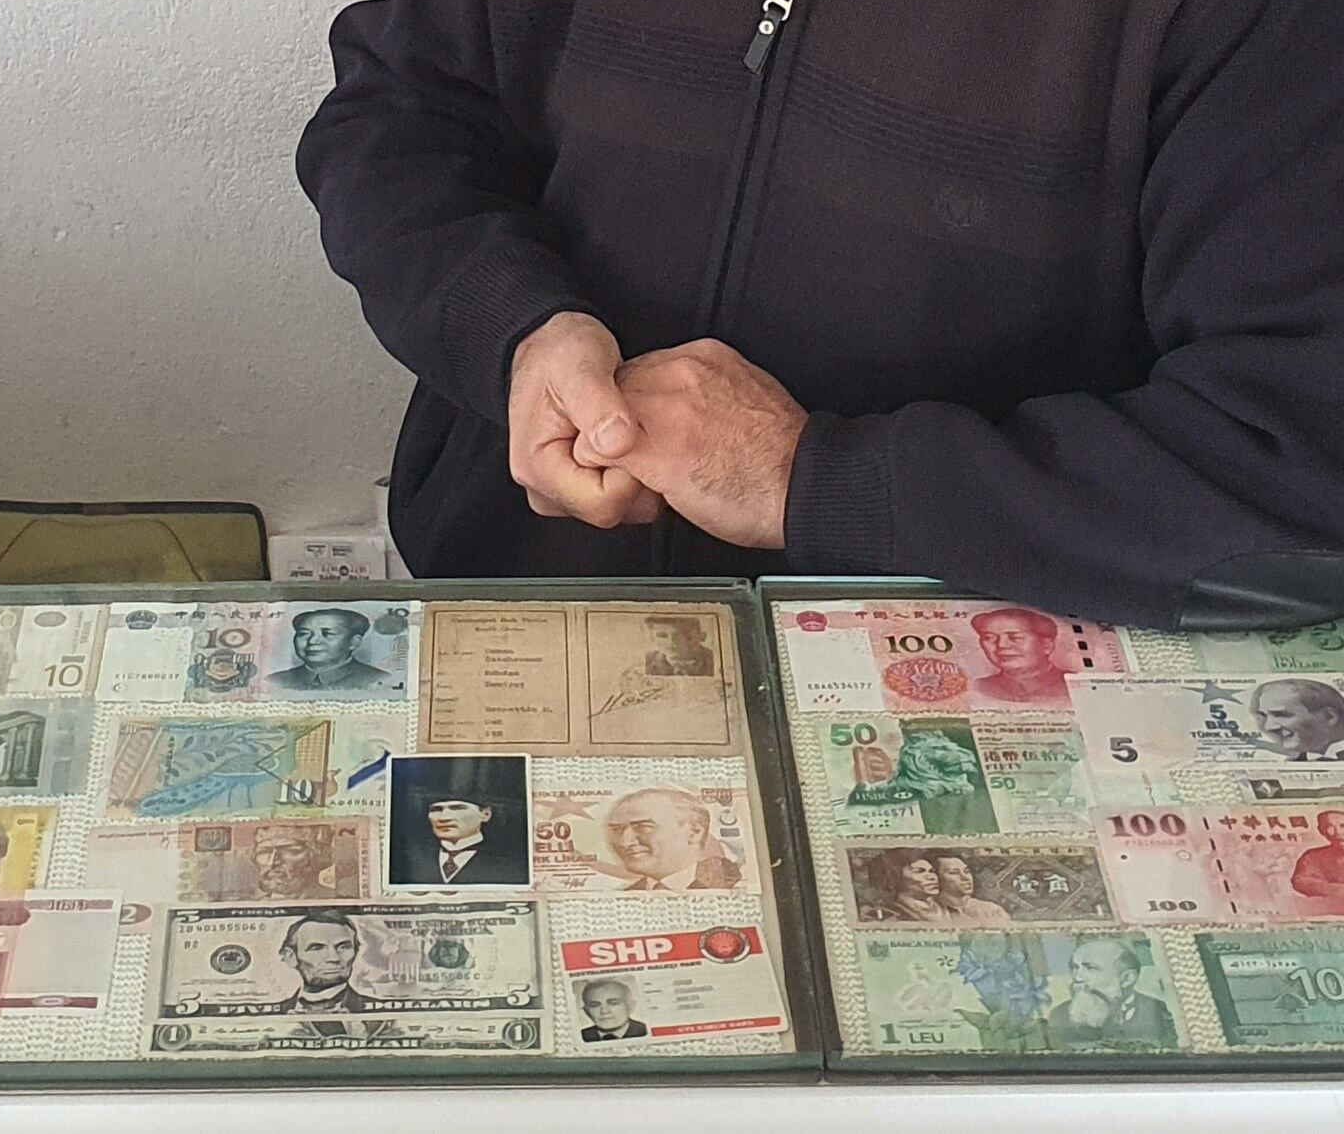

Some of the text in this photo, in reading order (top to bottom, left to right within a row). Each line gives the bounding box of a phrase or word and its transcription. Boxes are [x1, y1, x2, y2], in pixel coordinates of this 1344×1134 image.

[855, 610, 968, 621] 中国人民银行
[206, 628, 252, 649] 10
[885, 635, 953, 654] 100
[44, 663, 84, 688] 10
[1208, 704, 1228, 720] 5
[830, 722, 878, 746] 50
[1109, 737, 1138, 762] 5
[276, 778, 314, 805] 10
[532, 789, 565, 798] ERKEZ
[989, 776, 1016, 790] 50
[536, 822, 572, 840] 50
[1107, 813, 1187, 838] 100
[1218, 815, 1309, 830] 中華民國
[535, 841, 575, 852] ELLİ
[120, 904, 139, 923] 2
[176, 901, 531, 923] 5 5
[1147, 899, 1198, 912] 100
[588, 937, 673, 966] SHP
[175, 992, 492, 1015] 5 FIVE DOLLARS
[505, 983, 532, 1006] 5
[880, 1022, 945, 1044] 1 LEU
